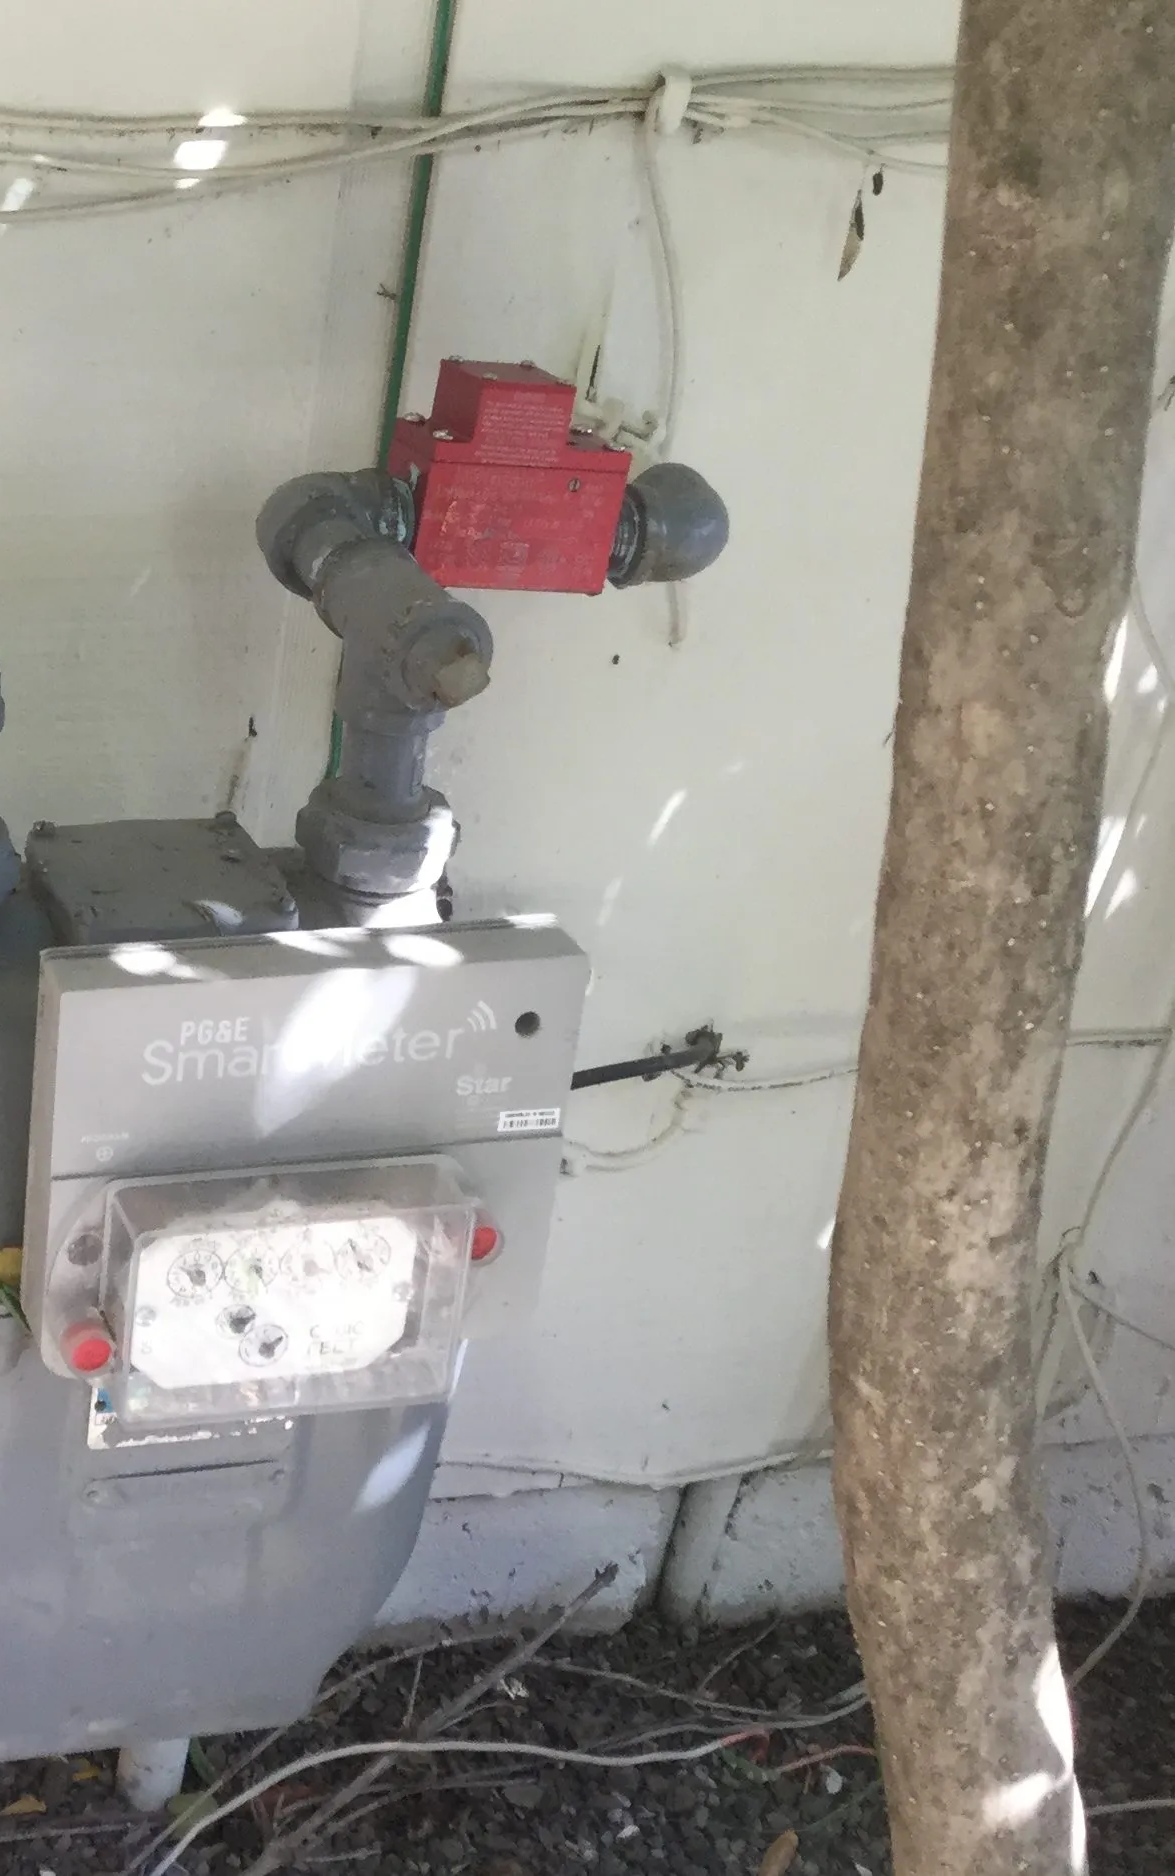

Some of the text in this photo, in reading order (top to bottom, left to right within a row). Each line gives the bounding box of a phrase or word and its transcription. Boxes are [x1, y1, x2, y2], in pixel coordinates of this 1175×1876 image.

[180, 1016, 251, 1046] PG&E
[141, 1025, 465, 1086] Smareter
[456, 1074, 512, 1096] Star
